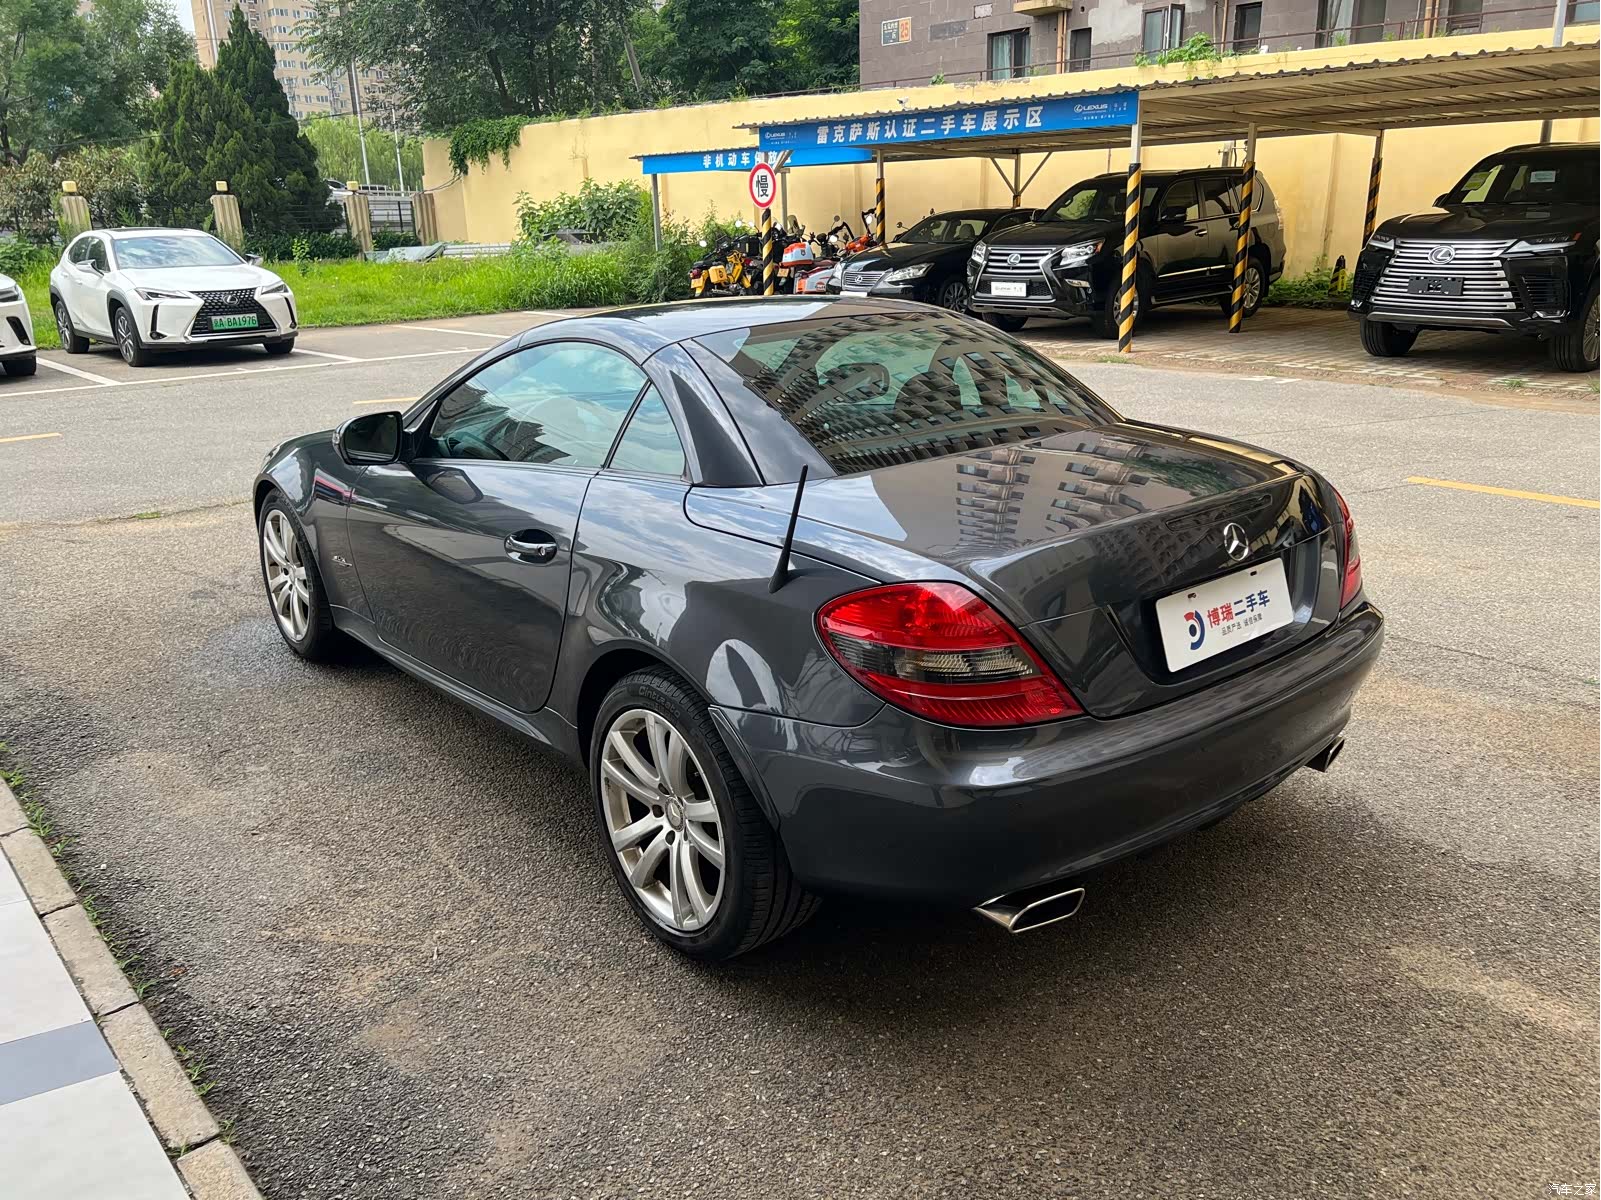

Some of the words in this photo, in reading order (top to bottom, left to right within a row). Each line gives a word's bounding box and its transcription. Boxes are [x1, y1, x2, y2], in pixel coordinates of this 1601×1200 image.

[1083, 103, 1108, 111] LEXUS
[816, 105, 1044, 144] 雷克萨斯认证二手车展示区
[756, 174, 769, 198] 慢
[1206, 589, 1271, 629] 博瑞二手车
